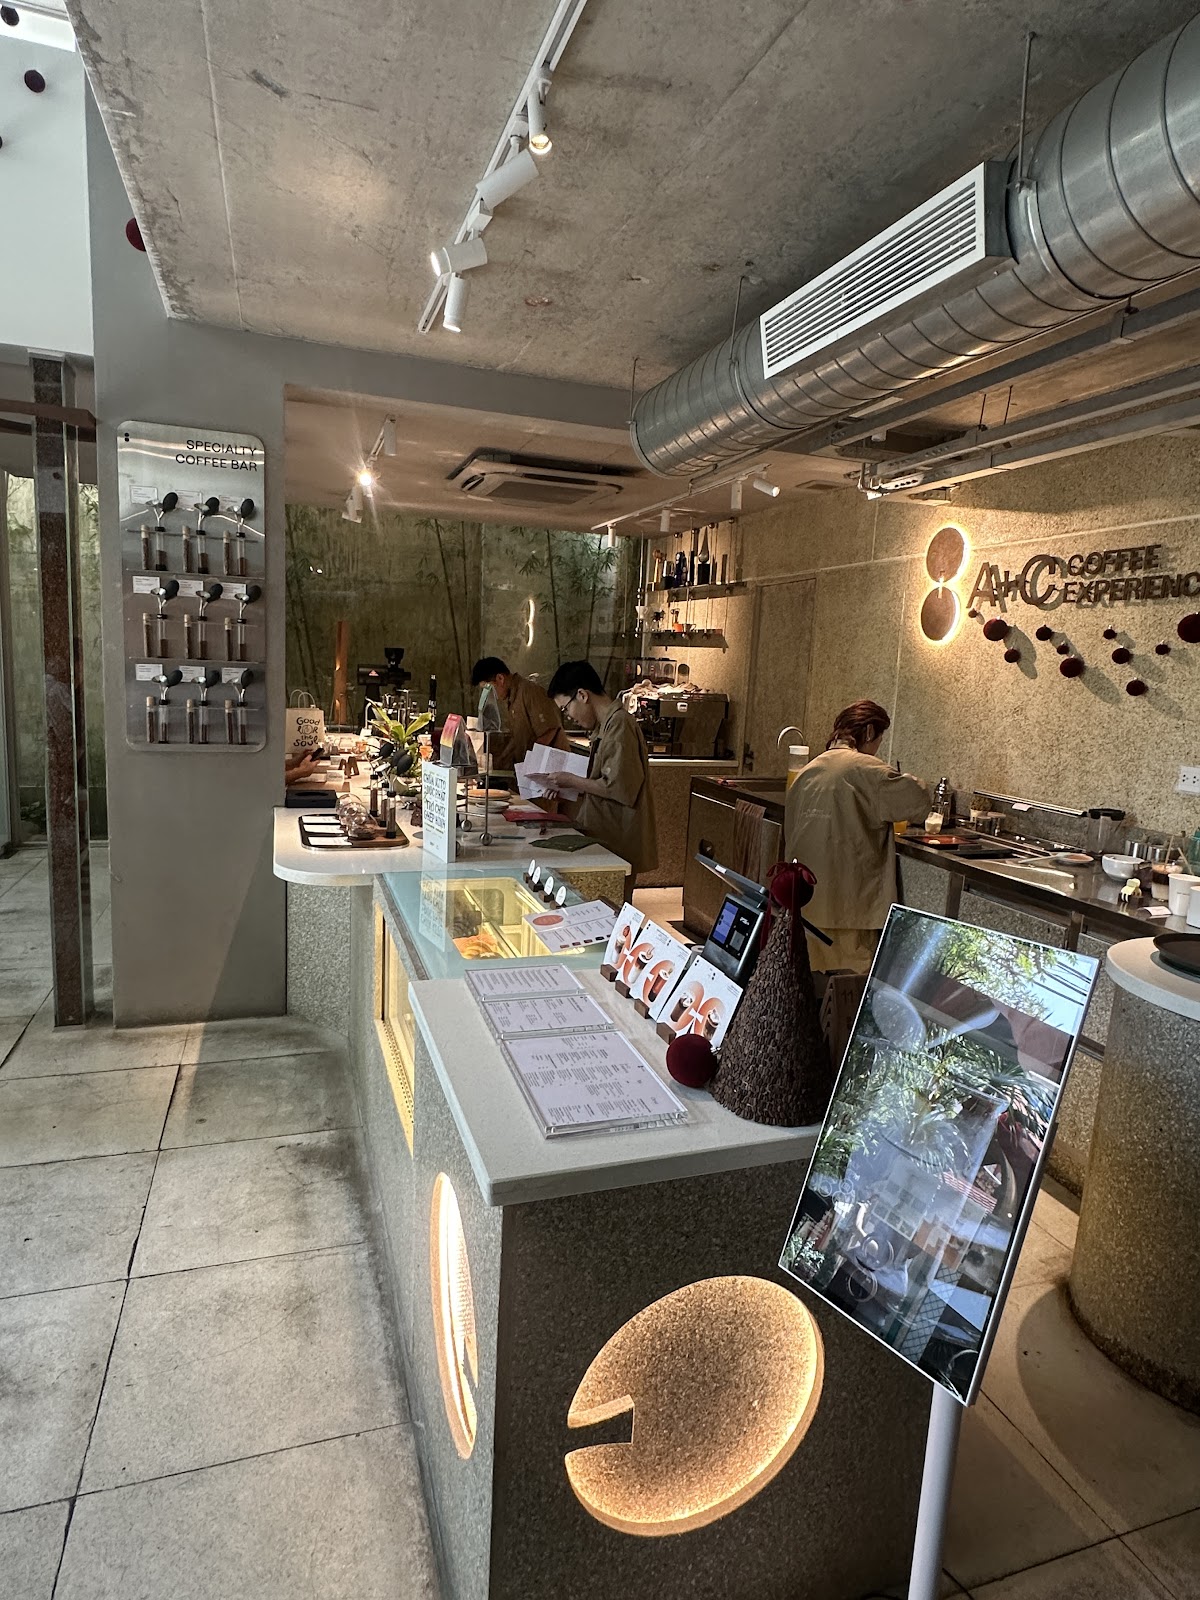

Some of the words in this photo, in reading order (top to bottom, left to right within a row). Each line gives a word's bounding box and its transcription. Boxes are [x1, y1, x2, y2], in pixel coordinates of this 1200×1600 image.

[186, 439, 257, 457] SPECIALTY
[175, 453, 228, 469] COFFEE
[231, 459, 258, 472] BAR
[1066, 544, 1162, 577] COFFEE
[296, 716, 320, 726] Good
